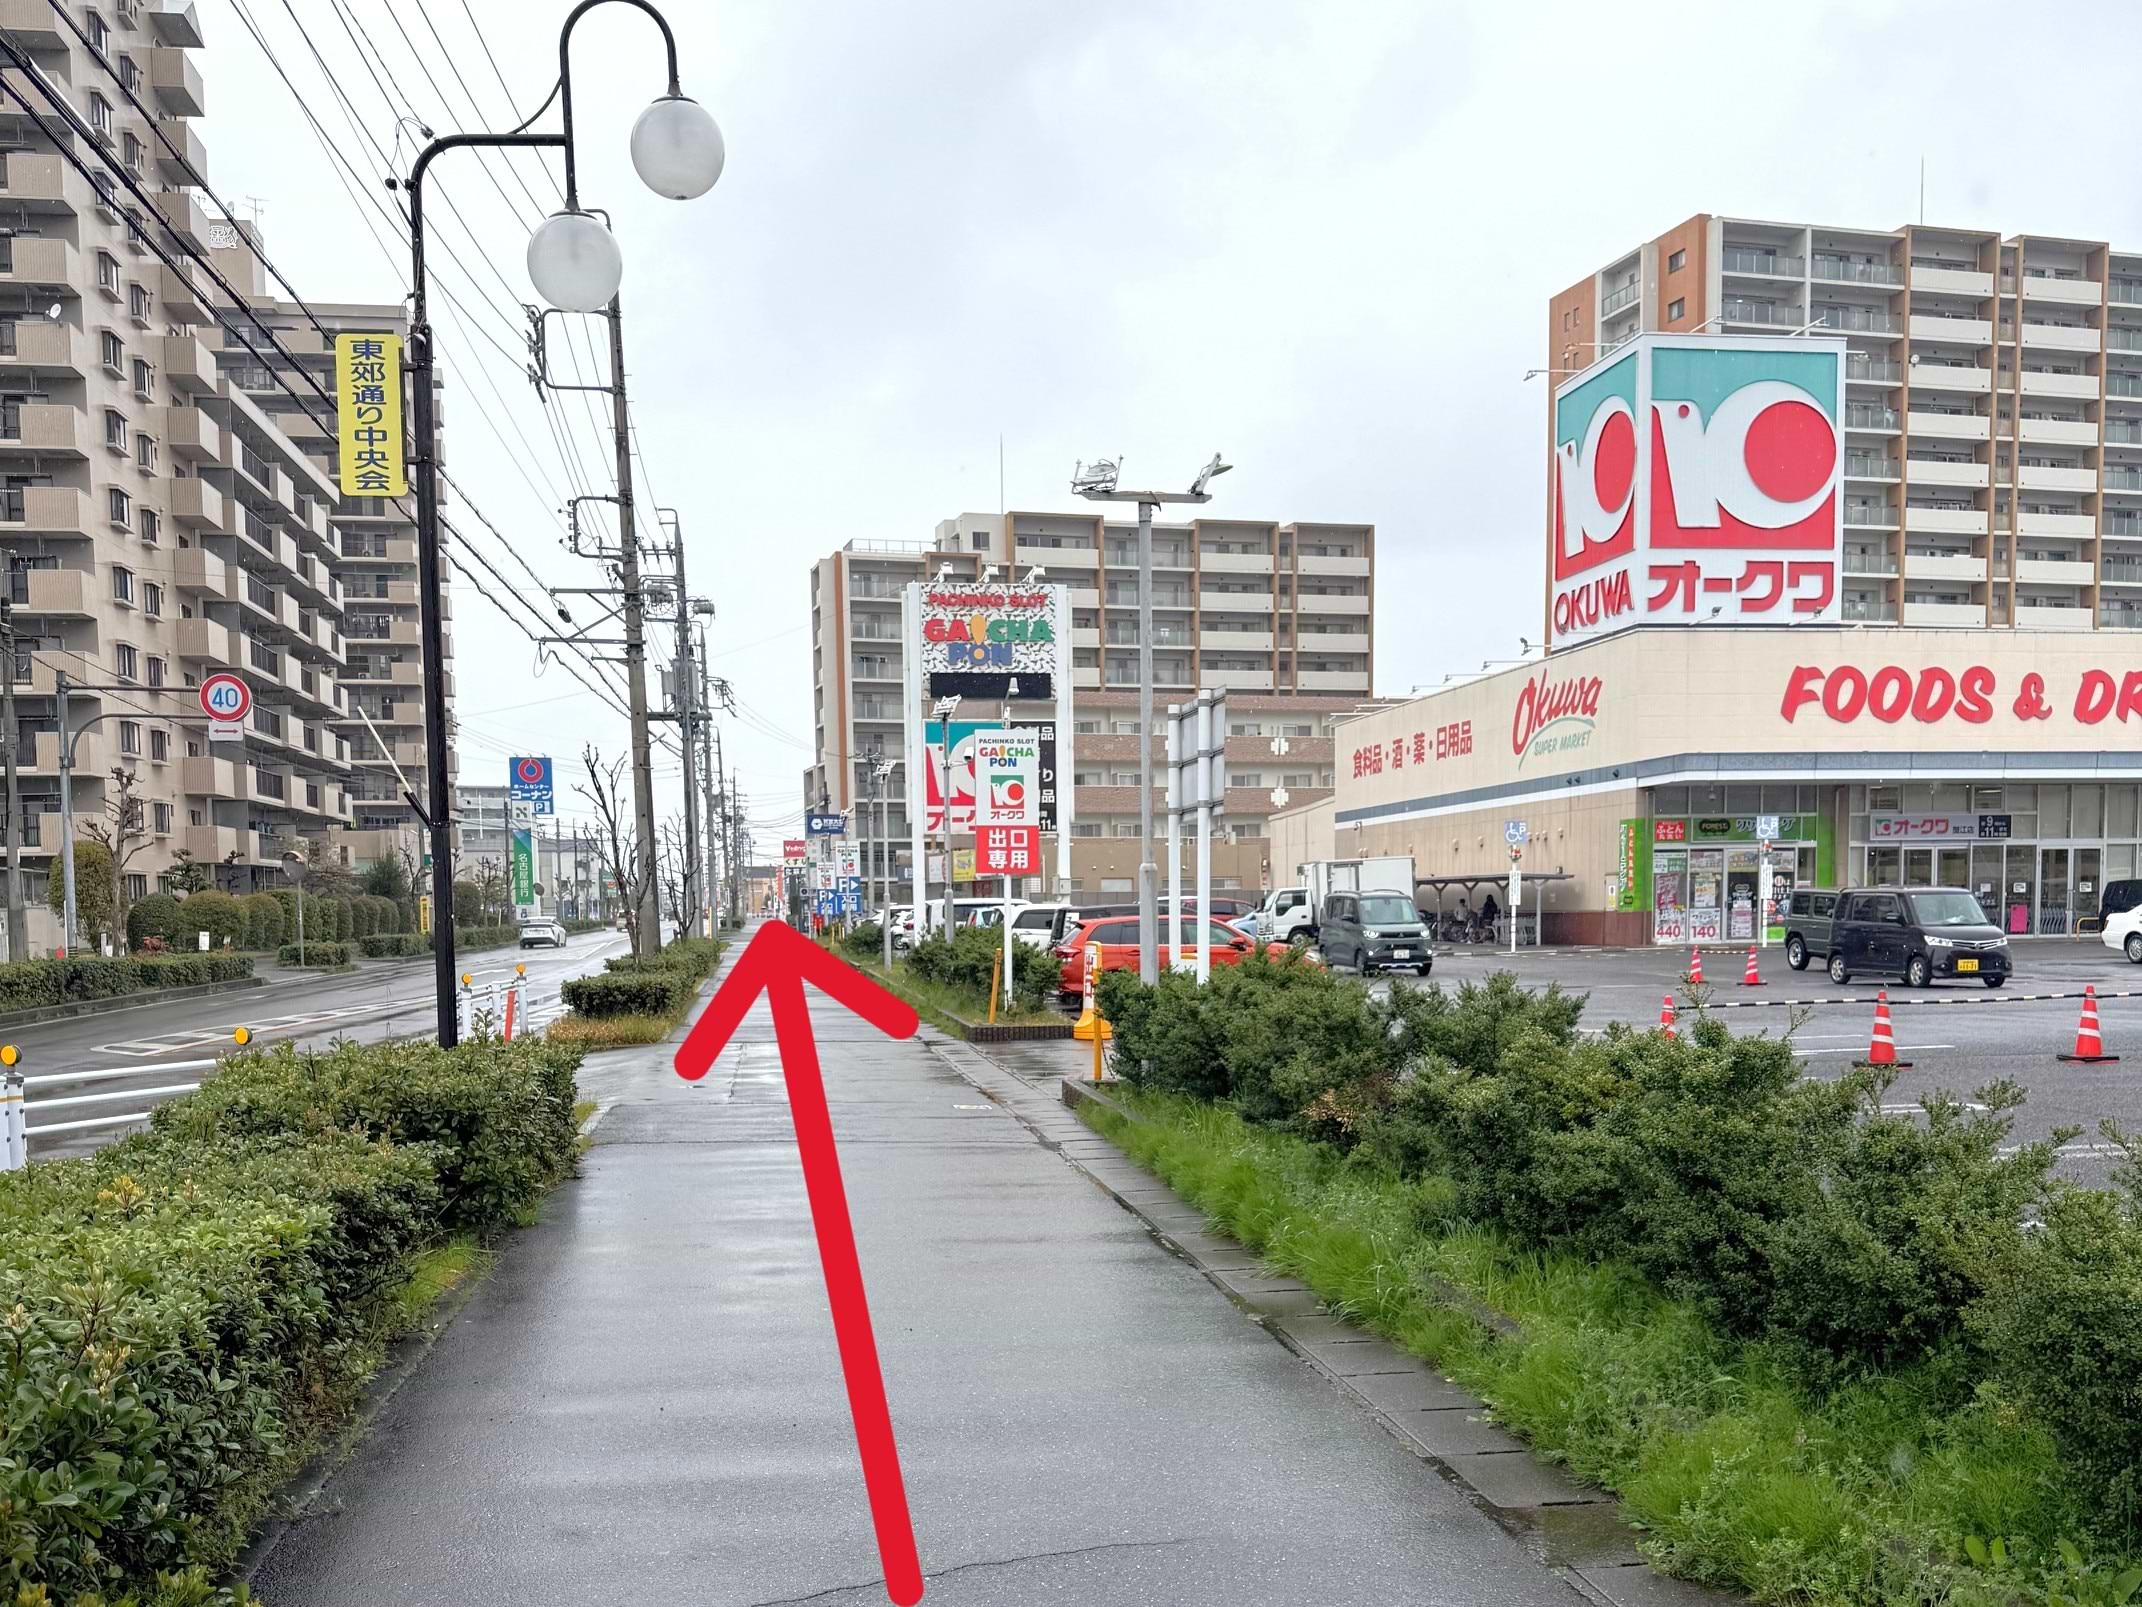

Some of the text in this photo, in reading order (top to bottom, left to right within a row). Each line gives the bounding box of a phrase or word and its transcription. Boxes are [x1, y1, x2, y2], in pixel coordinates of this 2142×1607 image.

[350, 339, 390, 491] 東郊通り中央会
[1648, 560, 1834, 612] オークワ
[929, 593, 1047, 607] PACHINKO SLOT
[1554, 569, 1634, 635] OKUWA
[948, 643, 1013, 666] PON
[212, 688, 238, 707] 40
[1781, 665, 1996, 724] FOODS
[2013, 672, 2052, 721] &
[1512, 668, 1602, 756] Okuwa
[1534, 730, 1592, 756] SUPER MARKET
[990, 758, 1017, 767] PON
[511, 790, 552, 799] コーナン
[536, 803, 543, 812] P
[991, 811, 1024, 819] オークワ
[1656, 825, 1683, 833] ふとん
[1894, 819, 1949, 834] オークワ
[1987, 816, 1993, 827] 9
[989, 828, 1028, 848] 出口
[1985, 827, 1994, 837] 11
[988, 850, 1028, 869] 専用
[518, 854, 529, 897] 名古屋銀行
[1657, 925, 1680, 937] 440
[1692, 926, 1716, 937] 140
